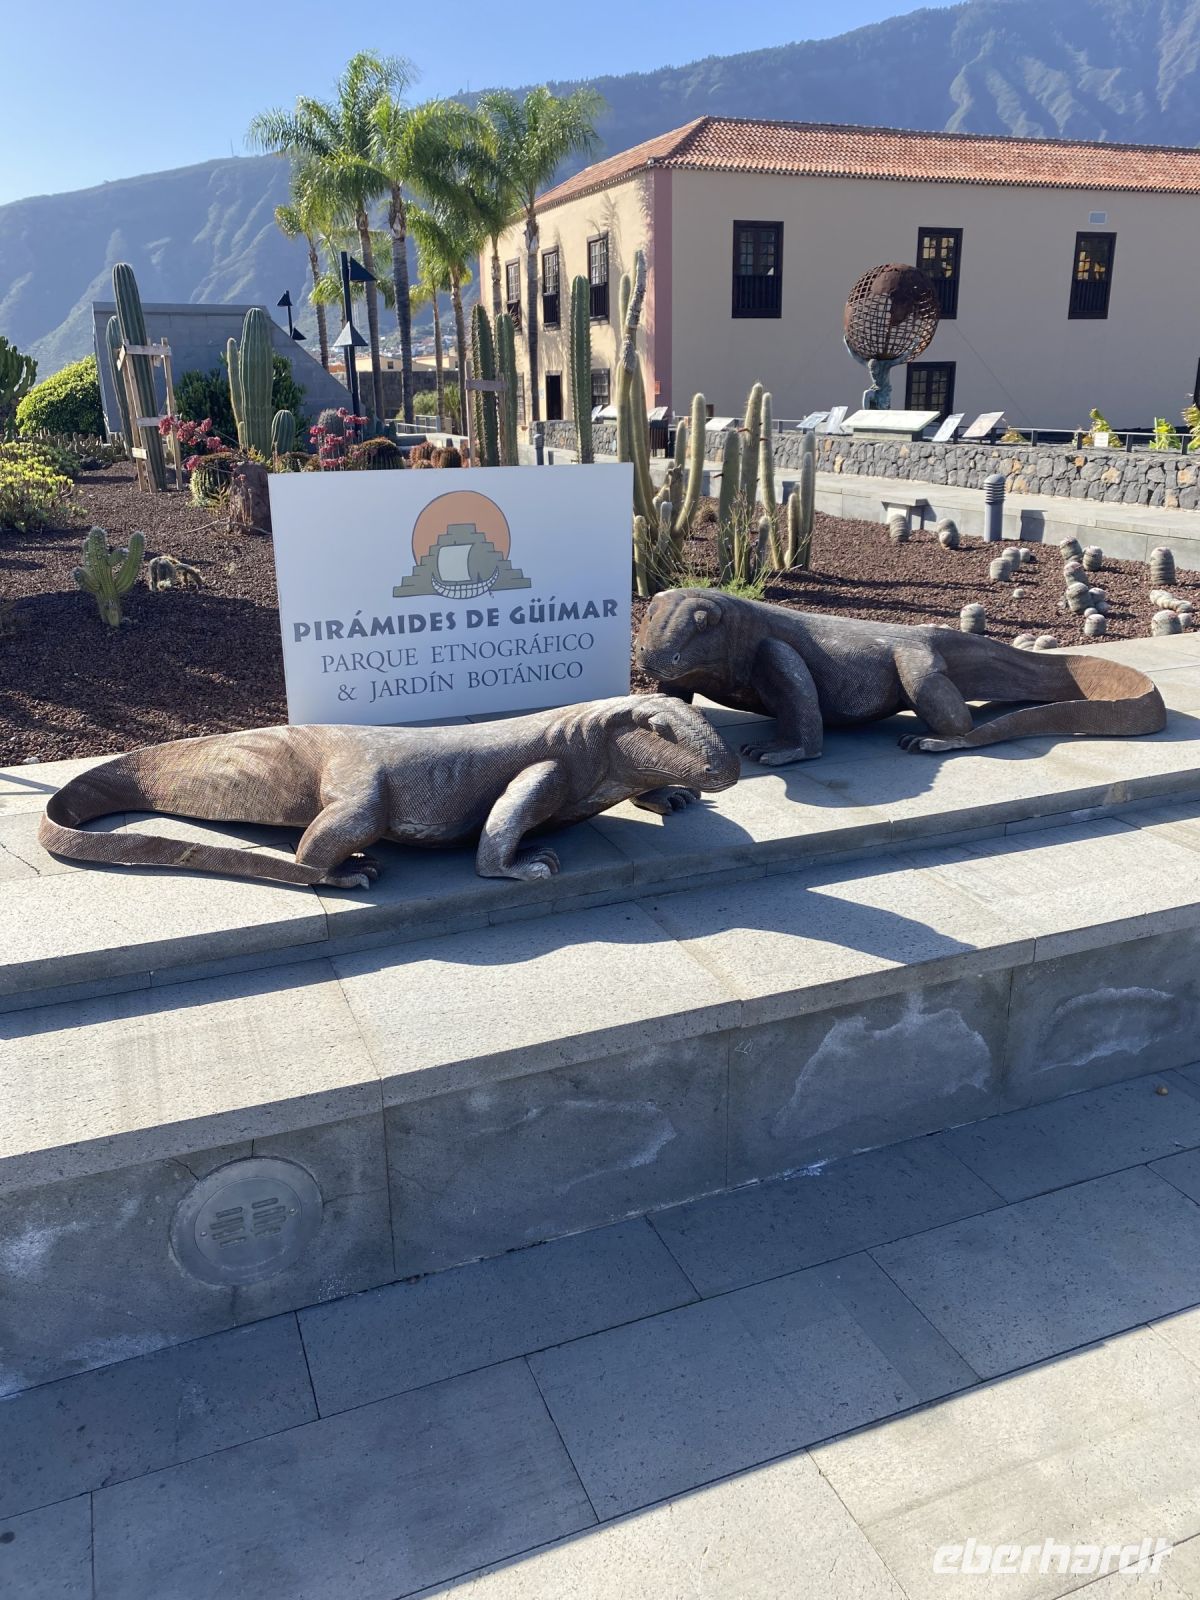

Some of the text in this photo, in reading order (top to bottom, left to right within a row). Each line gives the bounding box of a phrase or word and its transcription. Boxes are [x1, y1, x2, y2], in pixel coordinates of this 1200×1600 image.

[293, 596, 618, 643] PIRÁMIDES DE GÜÍMAR
[321, 632, 594, 674] PARQUE ETNOGRÁFICO
[338, 661, 584, 704] & JARDÍN BOTÁNICO
